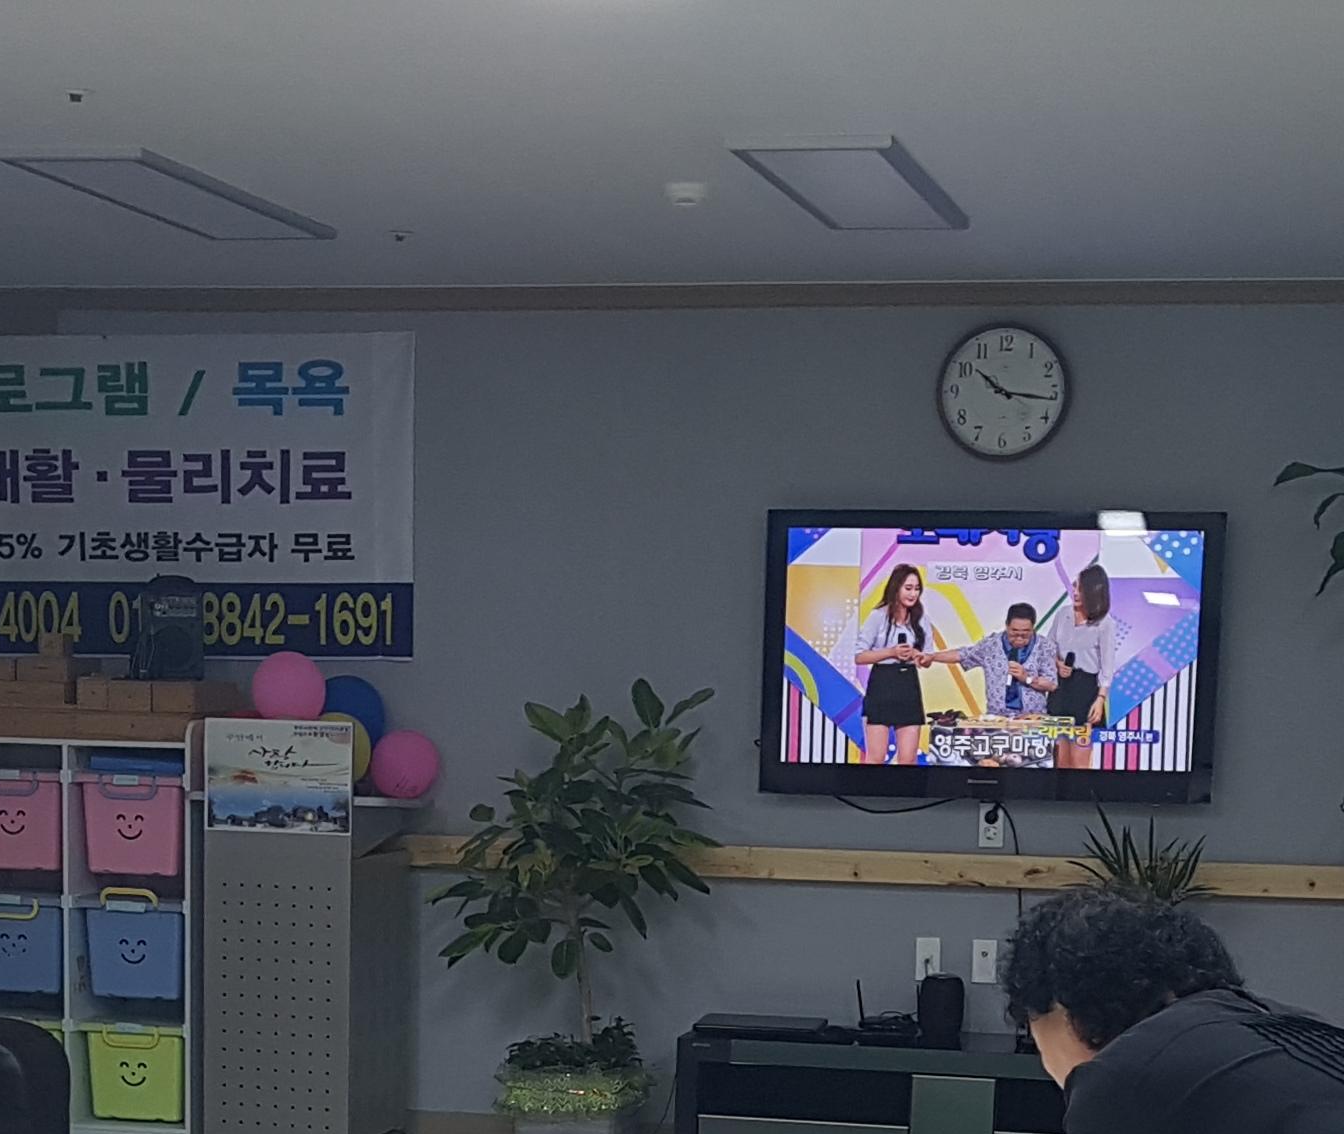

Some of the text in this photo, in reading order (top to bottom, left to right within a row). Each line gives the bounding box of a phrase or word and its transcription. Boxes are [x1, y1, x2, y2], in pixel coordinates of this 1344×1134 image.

[976, 343, 988, 359] 11
[999, 335, 1014, 351] 12
[958, 362, 973, 378] 10
[1044, 362, 1053, 378] 2
[231, 359, 350, 416] 목욕
[950, 384, 959, 398] 9
[957, 409, 967, 425] 8
[1040, 408, 1049, 424] 4
[974, 426, 983, 441] 7
[998, 433, 1007, 448] 6
[1023, 426, 1032, 441] 5
[58, 530, 278, 563] 기초생활수급자
[291, 532, 357, 563] 무료
